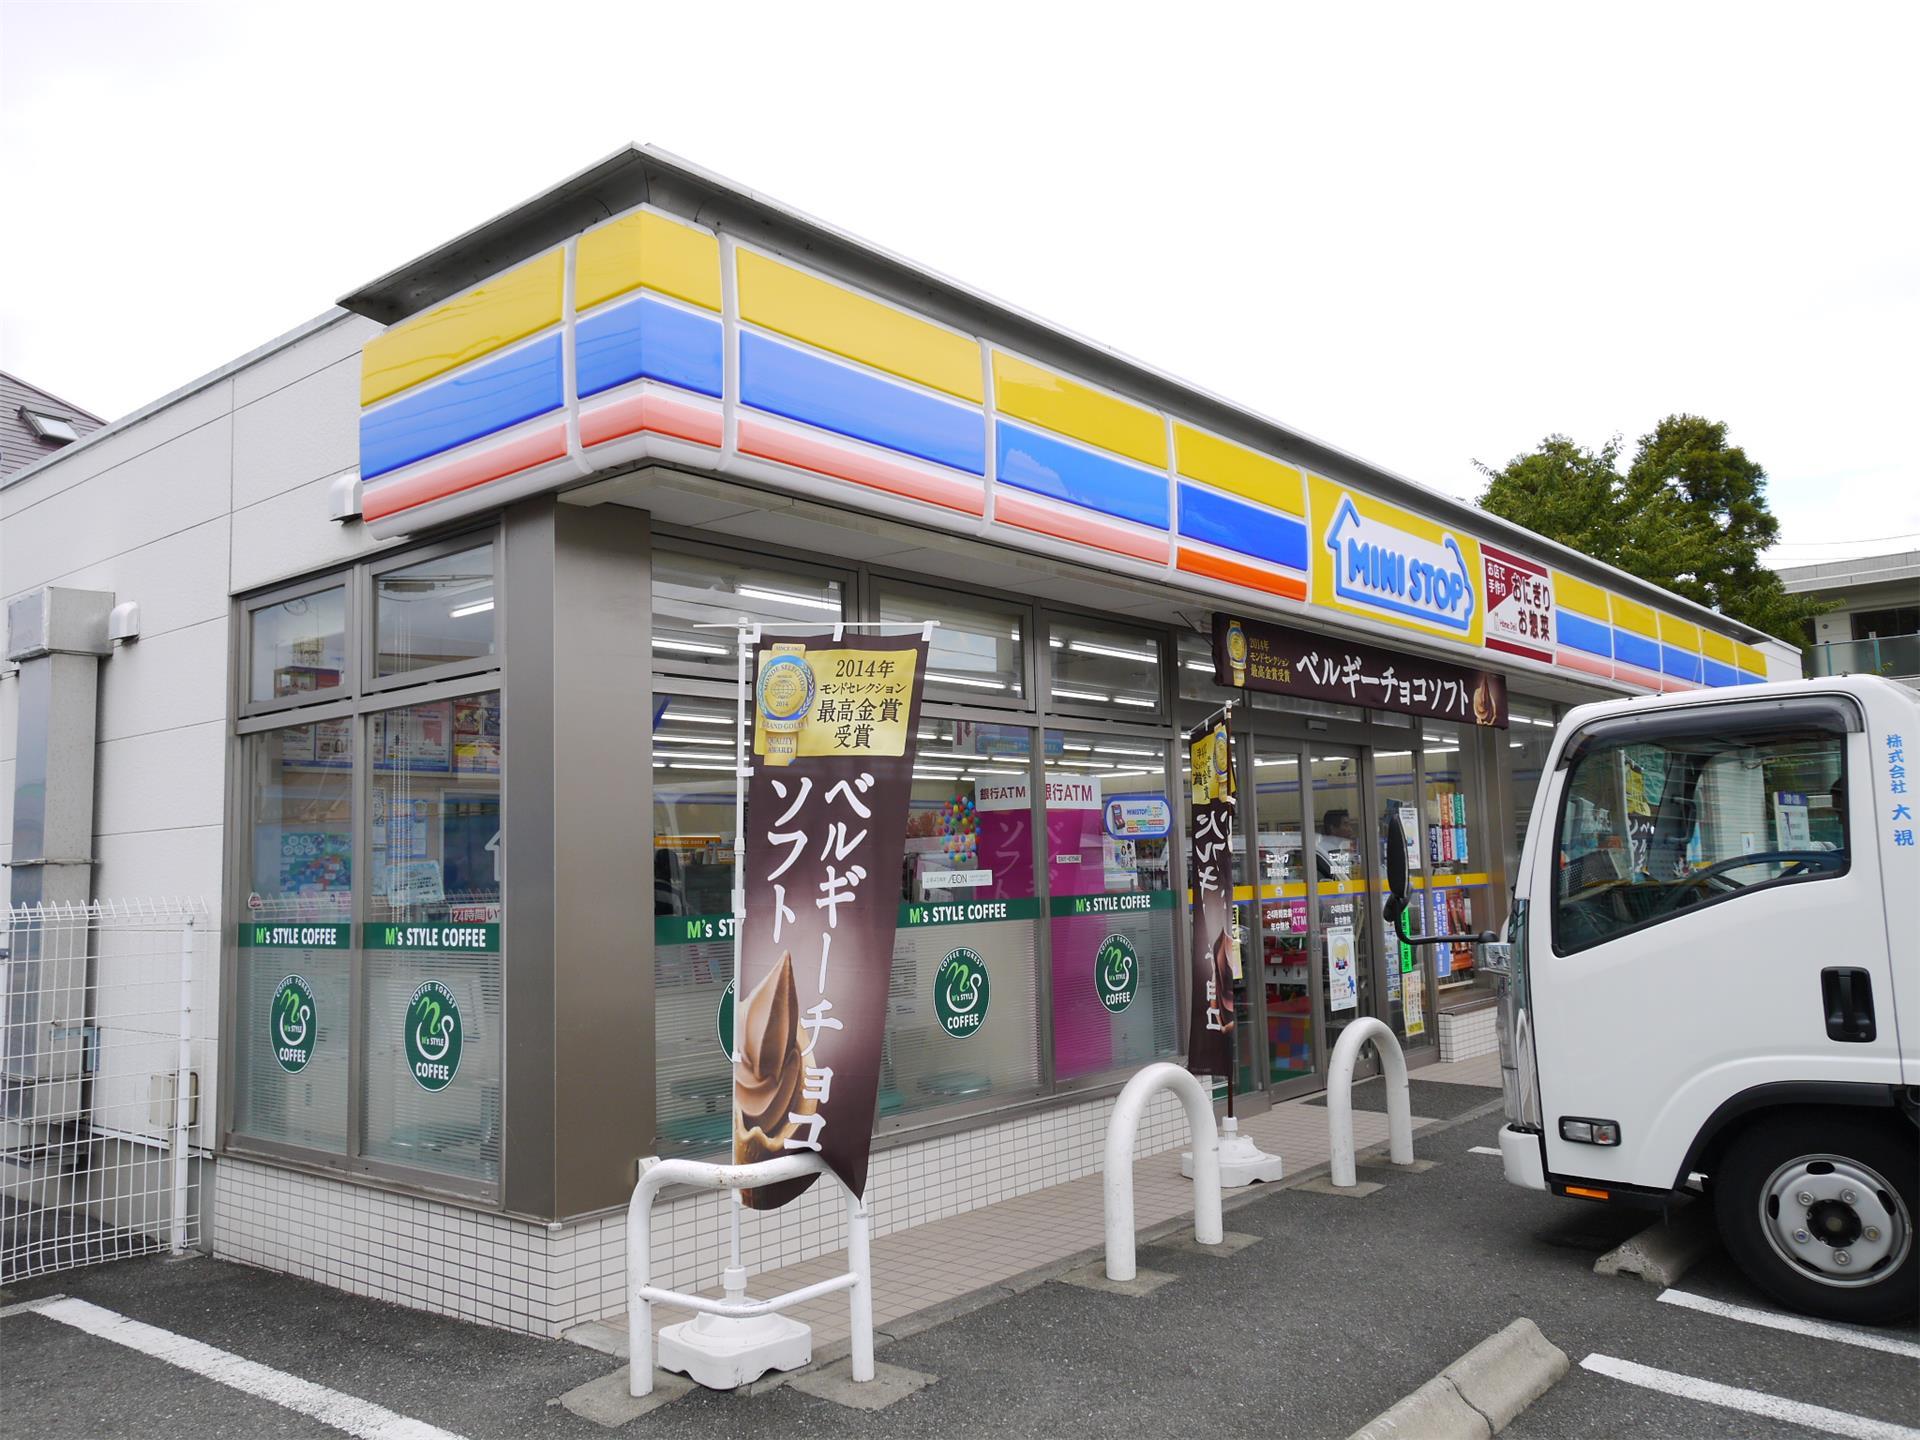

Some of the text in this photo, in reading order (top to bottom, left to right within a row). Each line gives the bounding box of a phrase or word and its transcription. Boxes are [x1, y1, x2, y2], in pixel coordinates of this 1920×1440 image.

[1348, 537, 1464, 612] MINI STOP
[1487, 562, 1506, 580] お店で
[1488, 579, 1507, 597] 手作り
[1511, 572, 1551, 612] おにぎり
[1518, 607, 1550, 641] お惣菜
[836, 659, 896, 679] 2014年
[819, 682, 908, 696] モンドセレクション
[1296, 650, 1470, 716] ベルギーチョコソフト
[816, 697, 904, 723] 最高金賞
[833, 723, 875, 750] 受賞
[1886, 733, 1908, 795] 株式会社
[979, 785, 1026, 800] 銀行ATM
[767, 776, 814, 945] ソフト
[909, 902, 1007, 924] M's STYLE COFFEE
[1075, 894, 1151, 913] M's STYLE COFFEE
[256, 926, 337, 946] M's STYLE COFFEE
[385, 927, 487, 948] M's STYLE COFFEE
[784, 772, 875, 1152] ベルギーチョコ
[940, 950, 984, 972] COFFEE FOREST
[276, 977, 313, 1000] COFFEE FOREST
[411, 983, 457, 1009] COFFEE FOREST
[1105, 991, 1131, 1006] COFFEE
[947, 1013, 980, 1030] COFFEE
[279, 1047, 307, 1064] COFFEE
[415, 1062, 450, 1081] COFFEE
